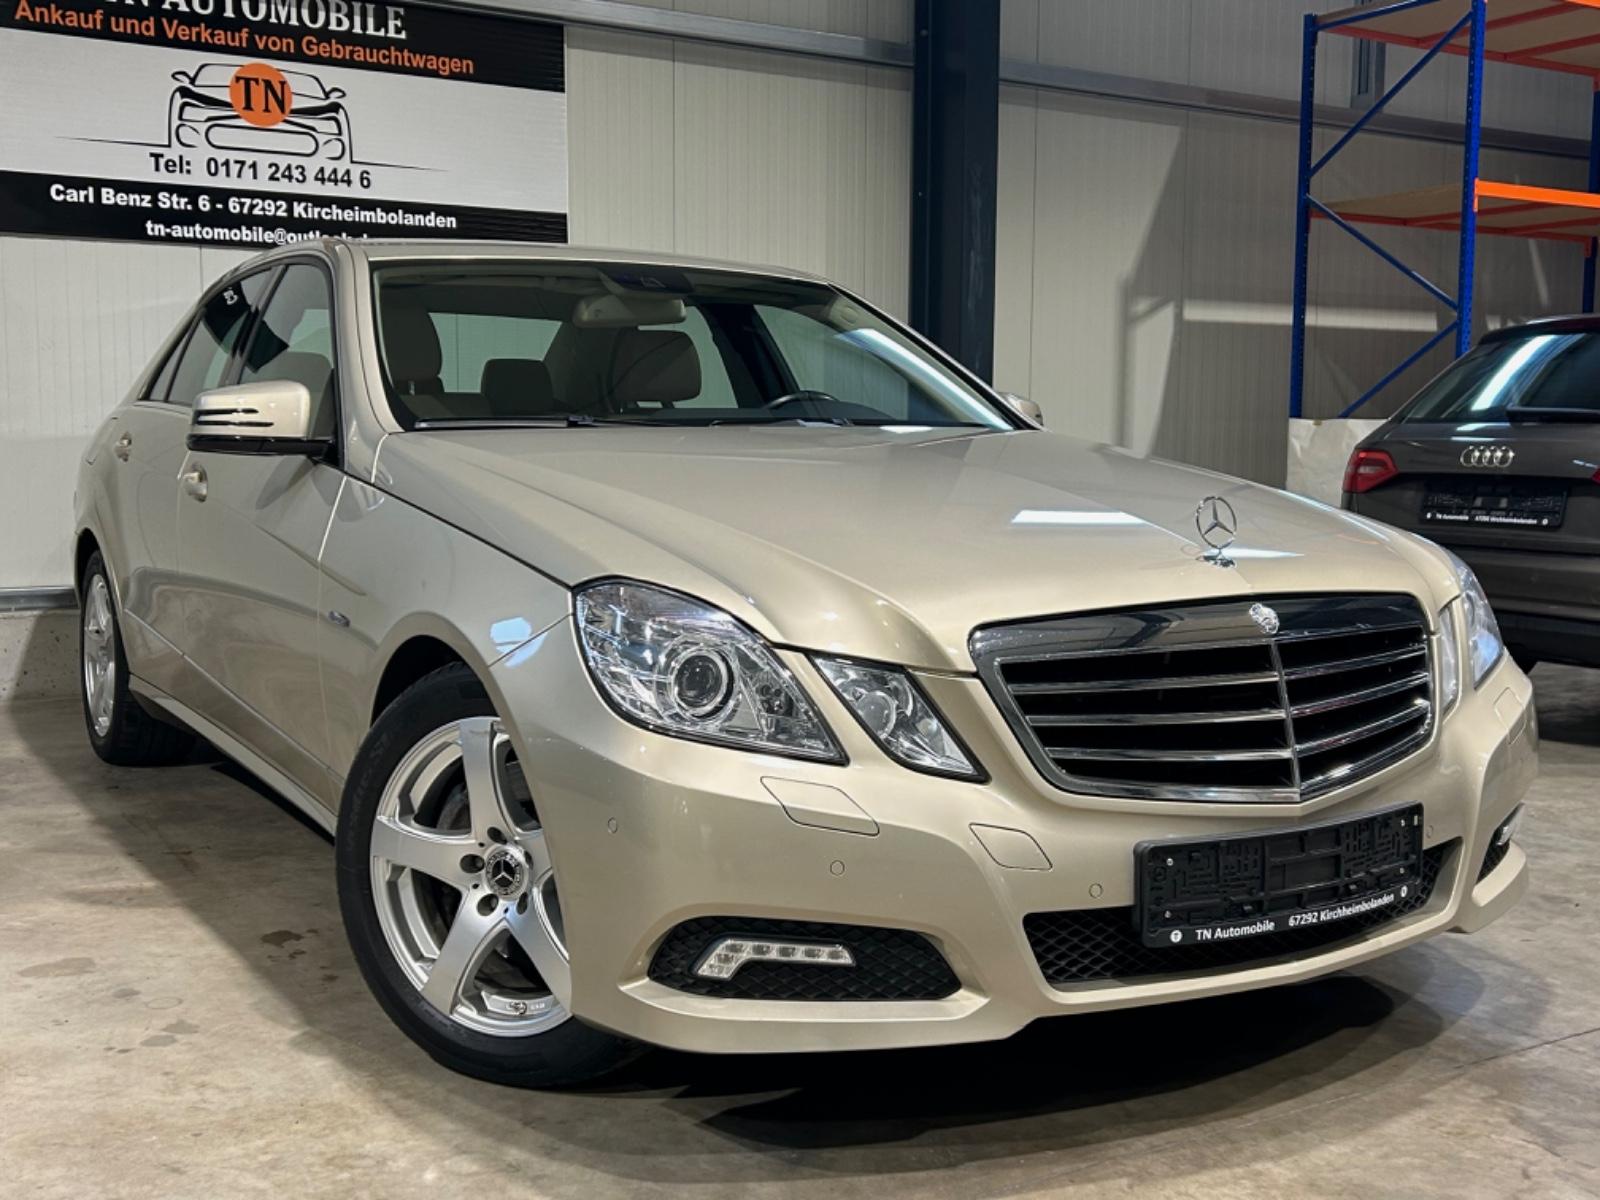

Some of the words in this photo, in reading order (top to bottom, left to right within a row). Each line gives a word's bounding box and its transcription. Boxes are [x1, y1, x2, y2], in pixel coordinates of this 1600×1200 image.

[15, 0, 104, 30] Ankauf
[111, 16, 155, 37] und
[162, 18, 249, 48] Verkauf
[254, 34, 295, 53] von
[301, 36, 474, 75] Gebrauchtwagen
[235, 76, 287, 114] TN
[150, 152, 192, 175] Tel:
[206, 157, 259, 180] 0171
[267, 162, 307, 183] 243
[314, 166, 352, 187] 444
[359, 170, 371, 189] 6
[50, 184, 94, 203] Carl
[101, 187, 152, 207] Benz
[157, 192, 193, 210] Str.
[198, 195, 211, 212] 6
[228, 197, 288, 217] 67292
[293, 202, 457, 228] Kircheimbolanden
[146, 220, 368, 244] tn-automobile@outl
[1195, 929, 1212, 941] TN
[1214, 920, 1275, 939] Automobile
[1288, 912, 1318, 927] 67292
[1320, 893, 1395, 921] Kirchheimbolanden
